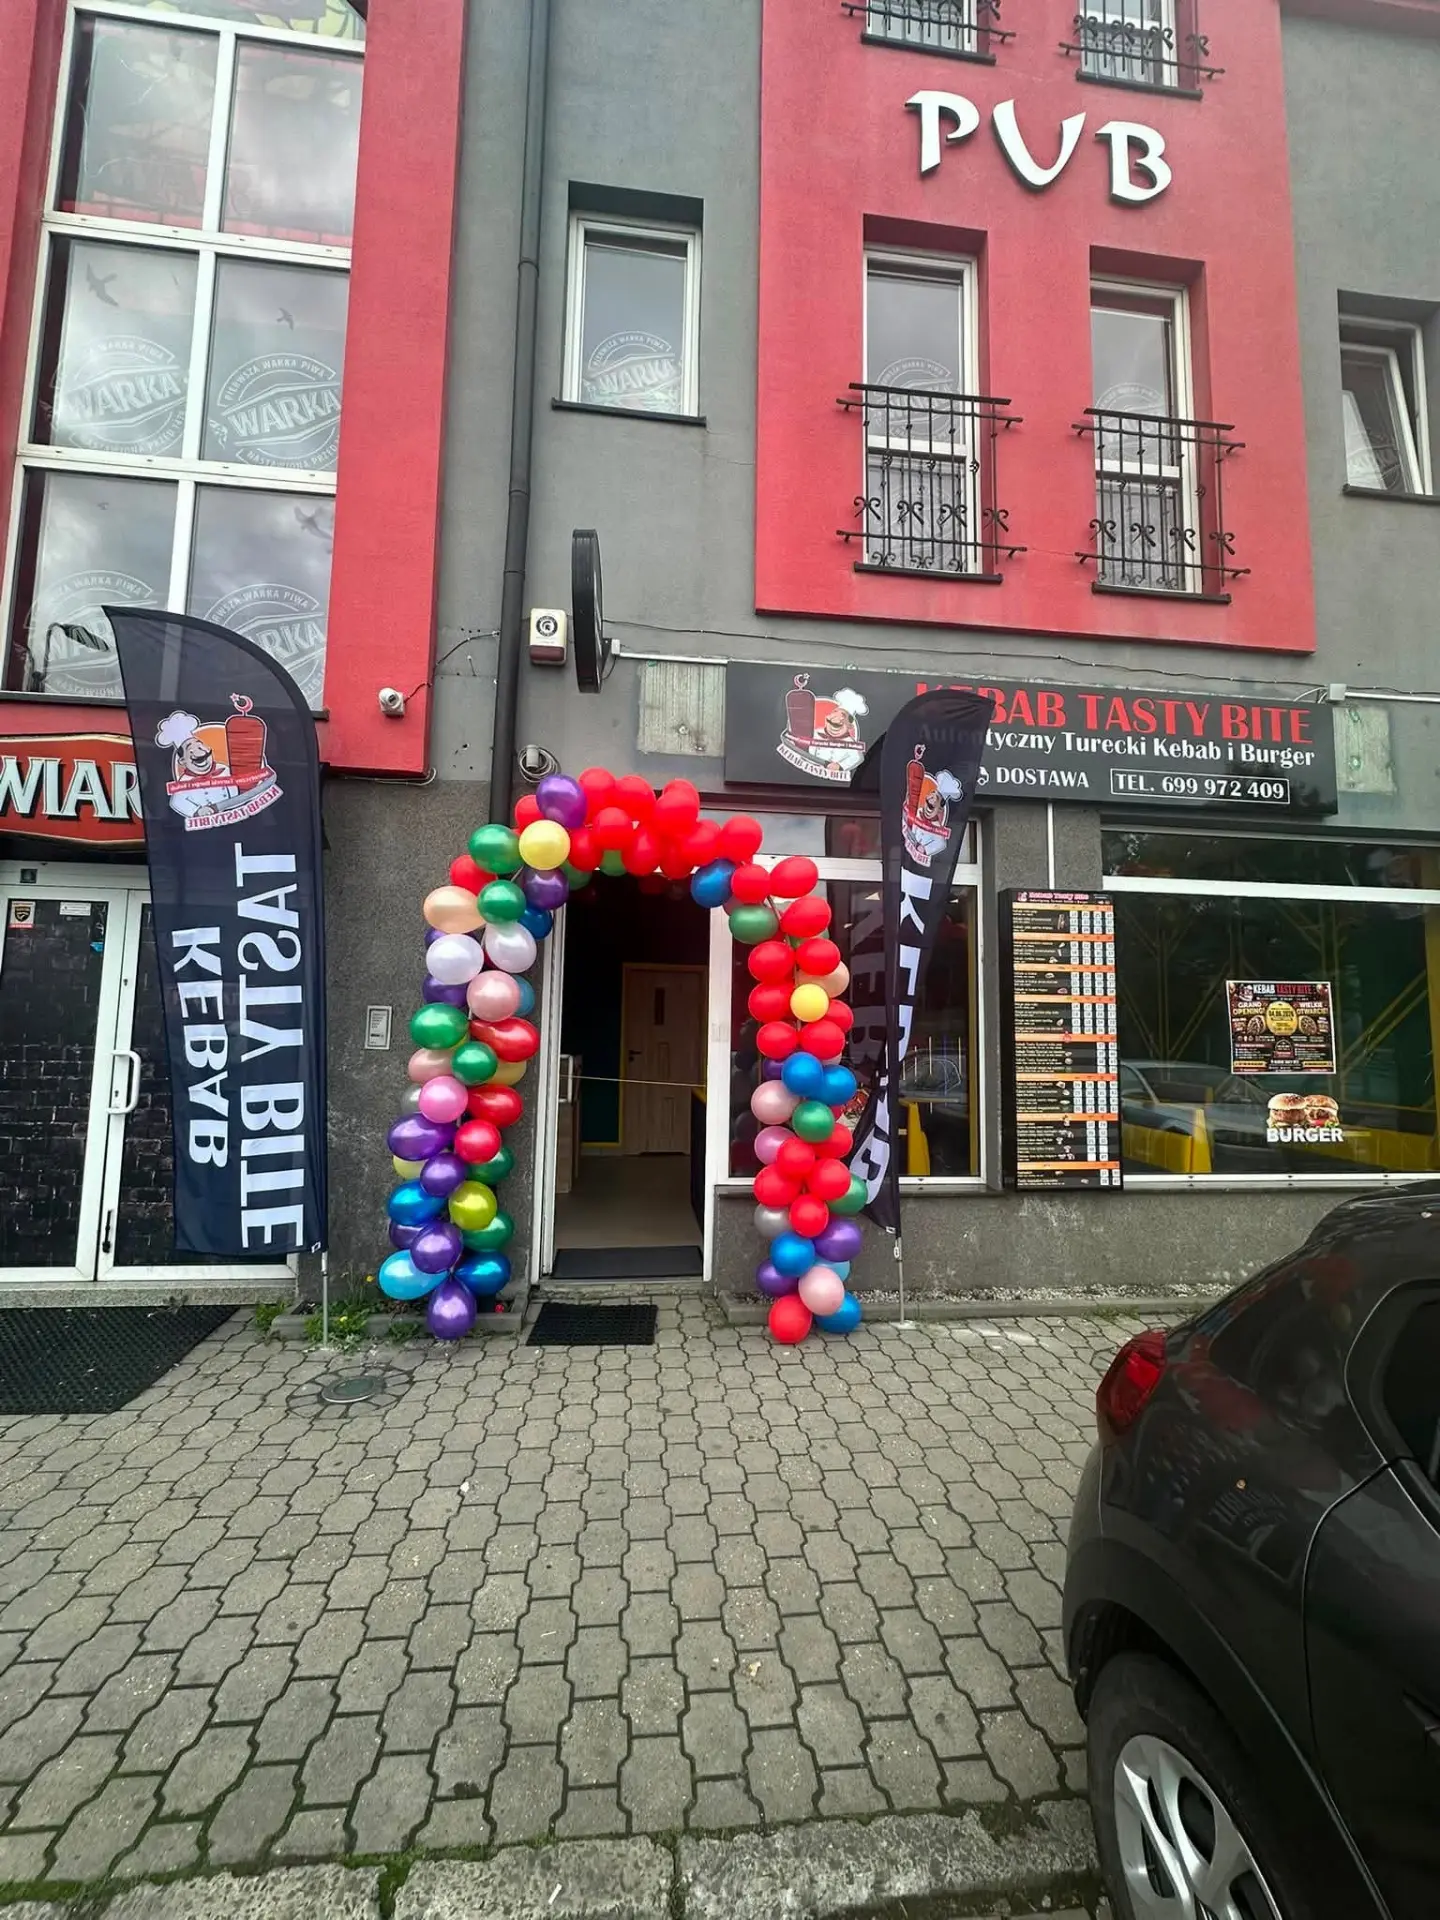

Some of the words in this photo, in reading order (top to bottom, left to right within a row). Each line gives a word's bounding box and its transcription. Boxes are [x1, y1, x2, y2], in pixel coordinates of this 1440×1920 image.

[65, 371, 181, 419] WARKA
[227, 388, 341, 437] WARKA
[1078, 692, 1210, 737] TASTY
[1221, 703, 1314, 745] BITE
[1061, 732, 1147, 756] Turecki
[1153, 737, 1221, 761] Kebab
[1227, 742, 1234, 761] i
[1241, 743, 1316, 769] Burger
[803, 763, 829, 778] TASTY
[996, 766, 1090, 788] DOSTAWA
[1115, 773, 1155, 792] TEL.
[1162, 776, 1198, 795] 699
[1204, 779, 1242, 797] 972
[1247, 782, 1285, 799] 409
[1252, 984, 1276, 994] KEBAB
[1266, 1127, 1345, 1143] BURGER
